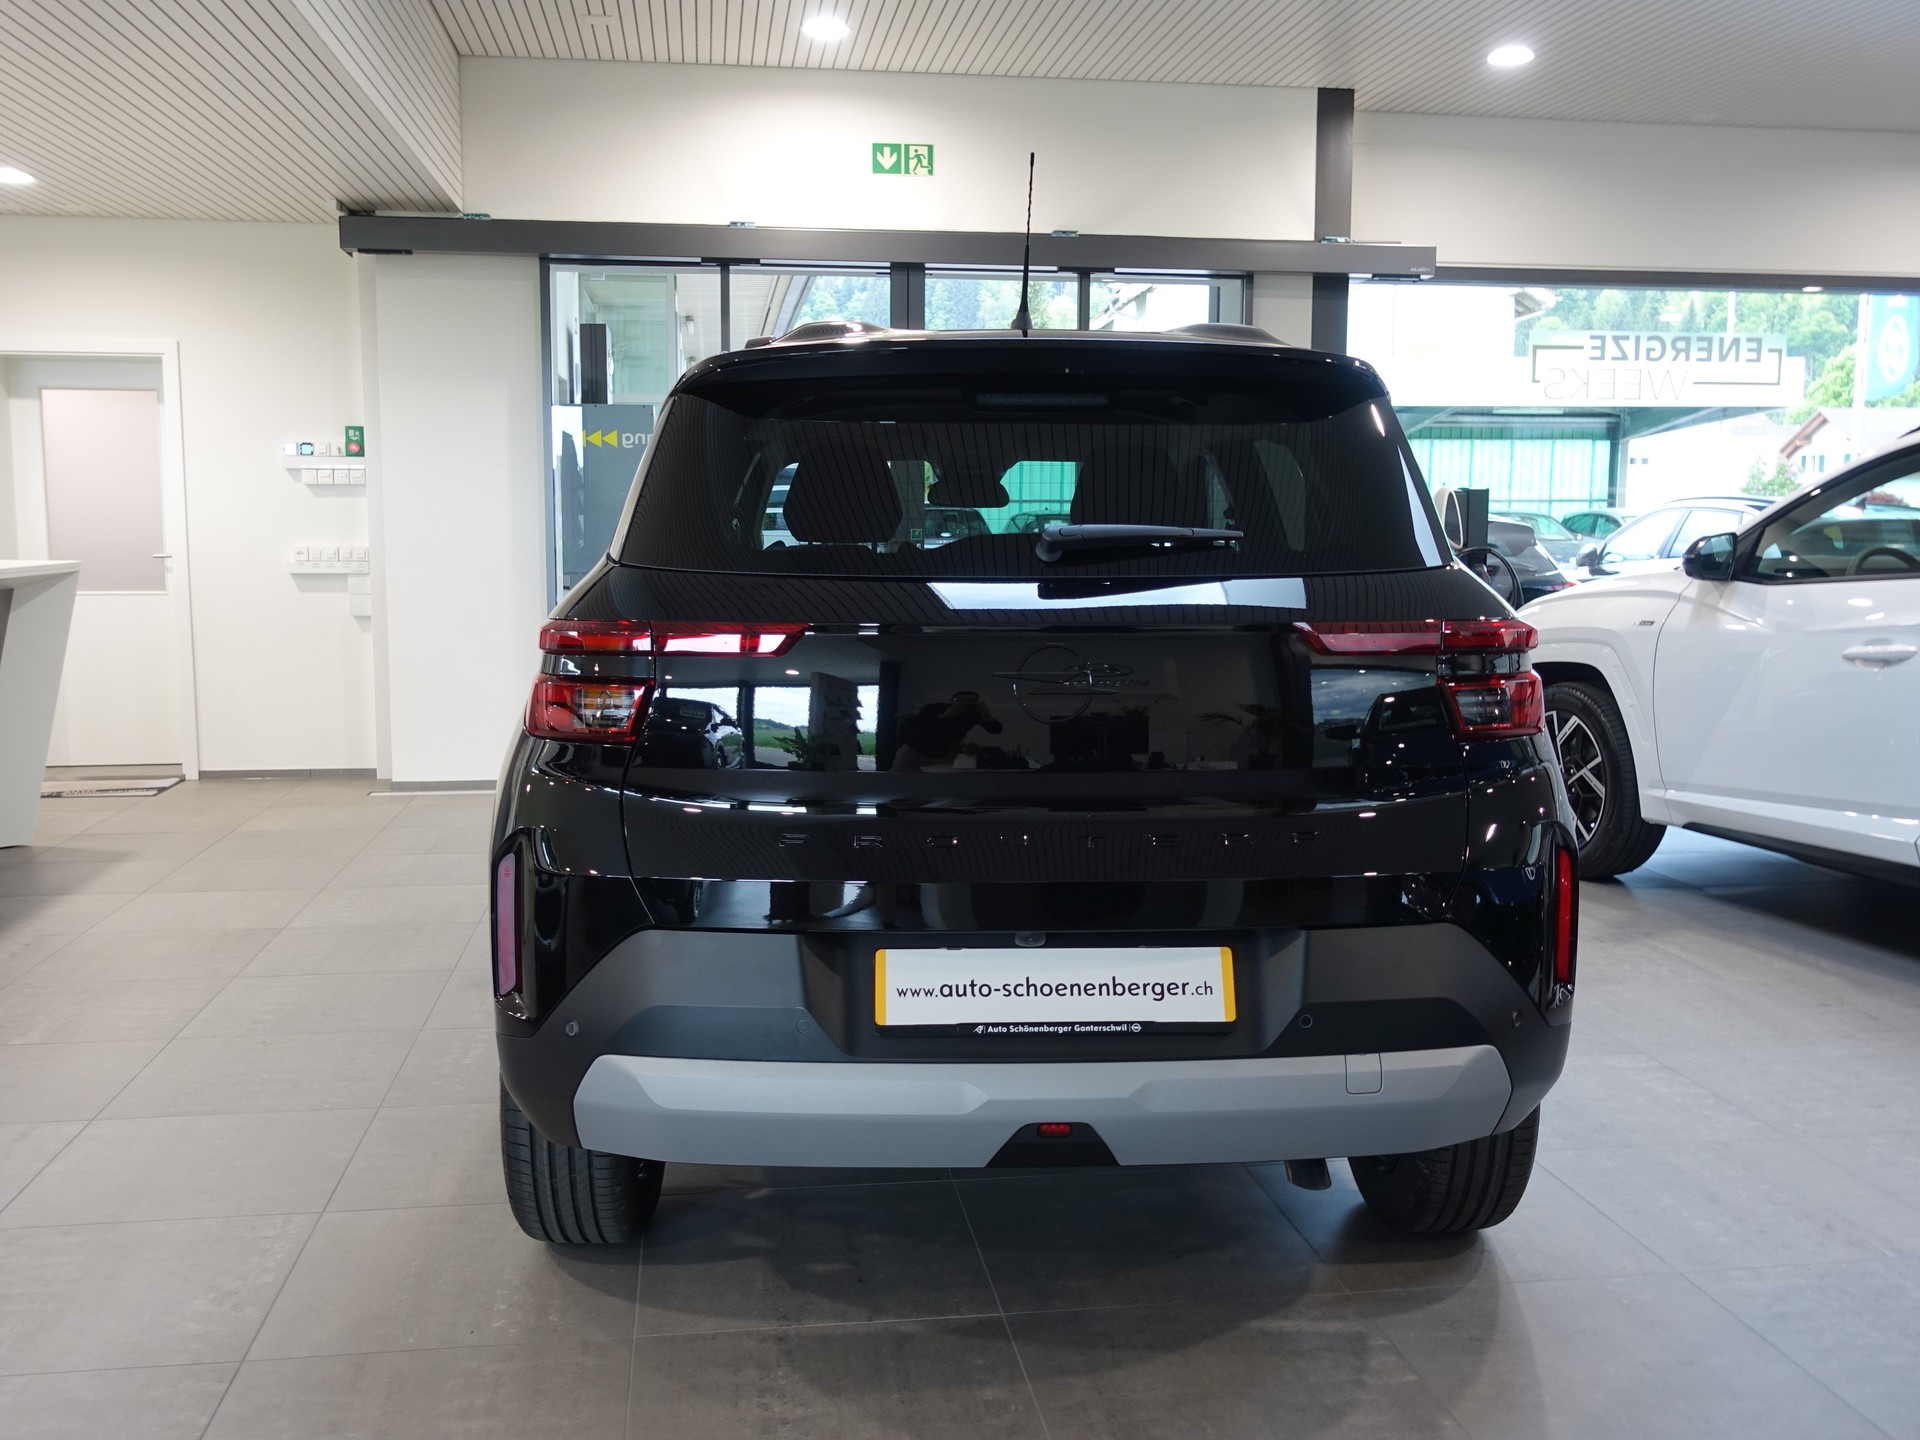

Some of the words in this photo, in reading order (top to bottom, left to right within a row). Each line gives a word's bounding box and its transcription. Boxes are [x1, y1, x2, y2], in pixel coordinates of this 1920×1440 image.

[896, 975, 1213, 1002] www.auto-schoenenberger.ch
[987, 1025, 1007, 1033] Auto
[1009, 1024, 1072, 1034] Schönenberger
[1074, 1023, 1127, 1032] Ganterschwil
